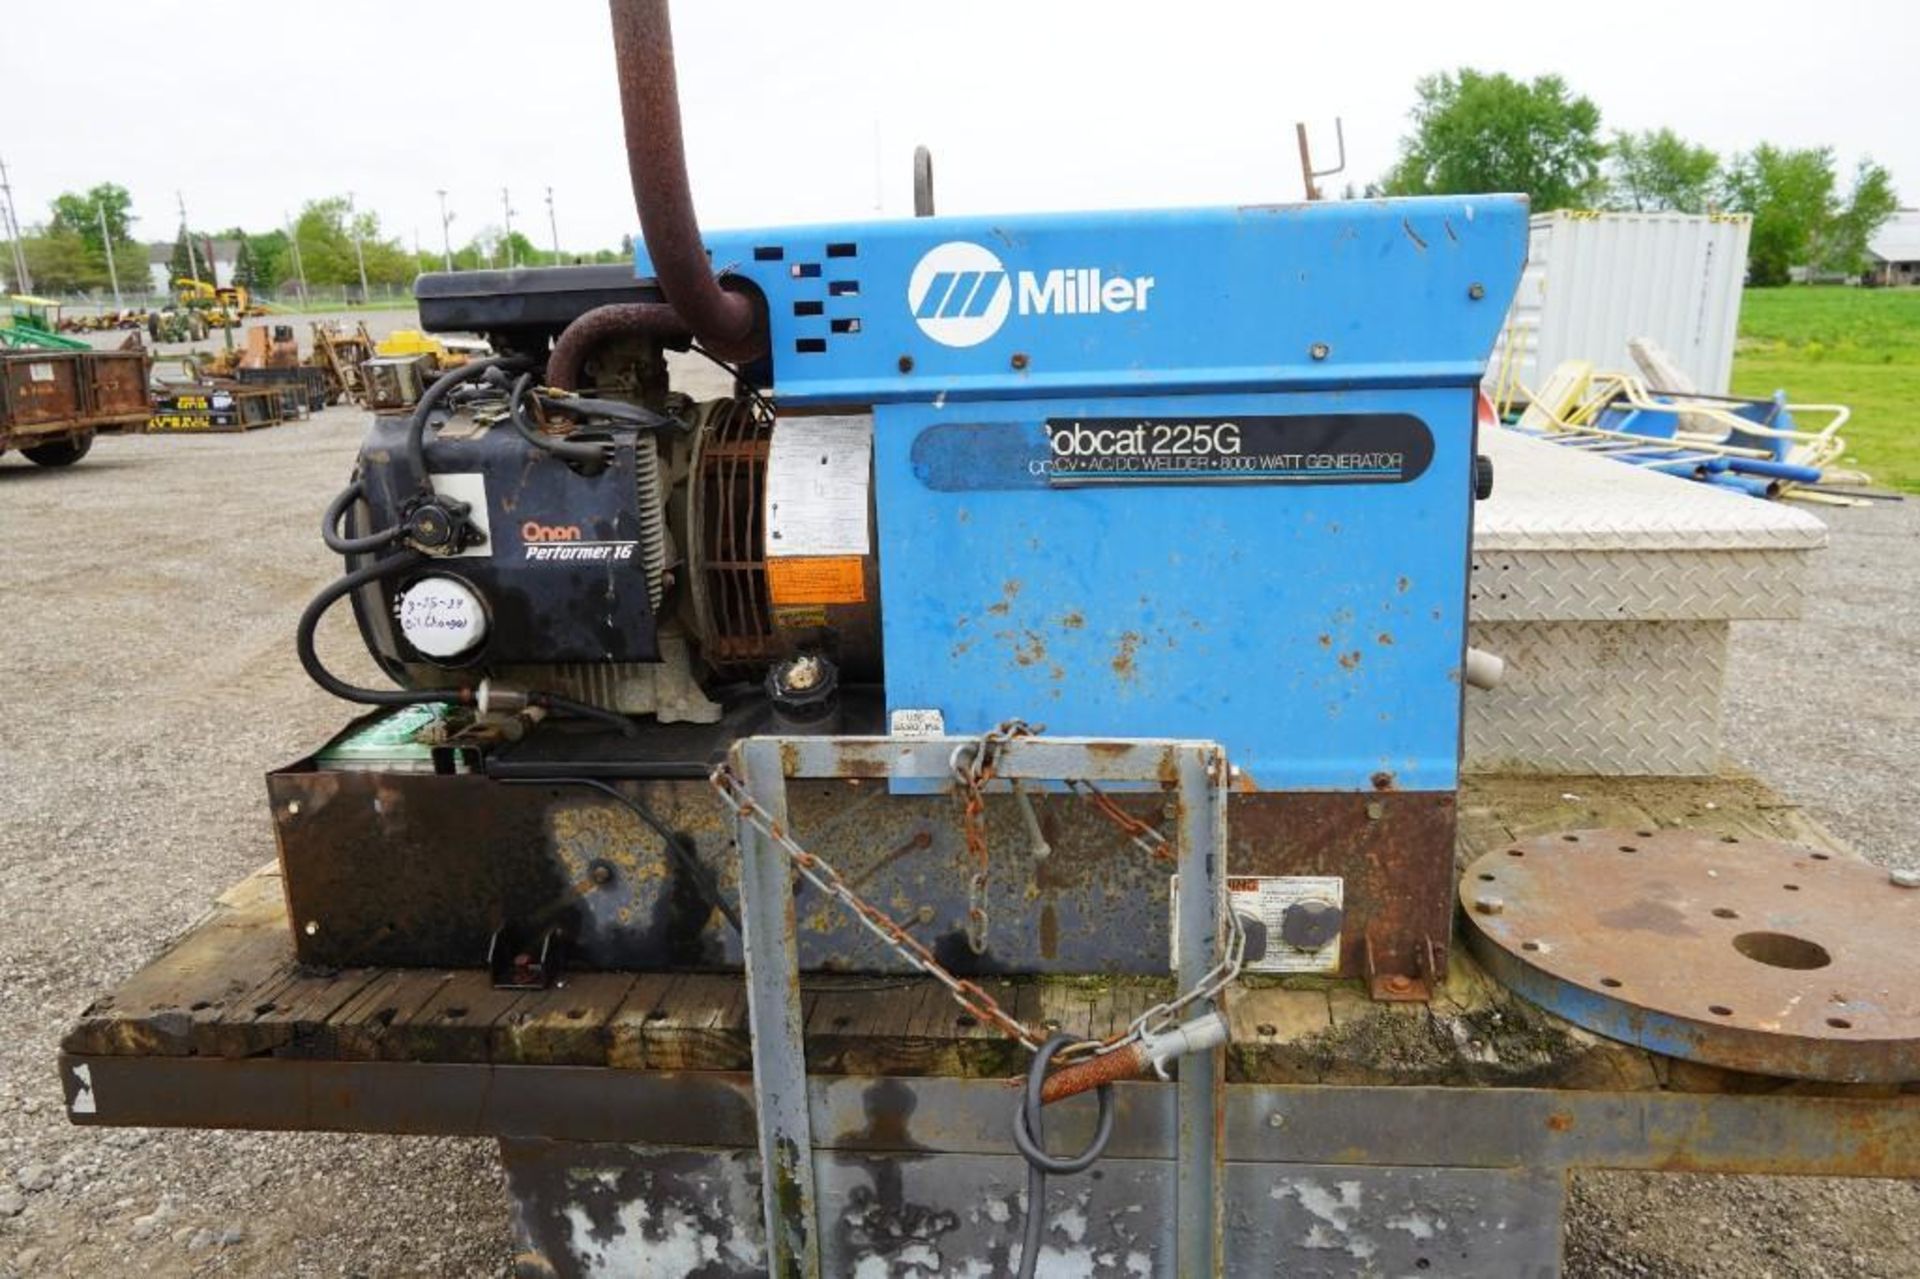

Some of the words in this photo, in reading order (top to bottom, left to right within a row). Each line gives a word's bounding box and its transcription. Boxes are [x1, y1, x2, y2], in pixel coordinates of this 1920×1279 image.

[1018, 268, 1155, 315] Miller
[1045, 422, 1145, 455] obcat
[1151, 422, 1242, 455] 225G
[1088, 456, 1140, 472] AC/DC
[1142, 456, 1208, 471] WELDER
[1220, 456, 1257, 470] 8000
[1259, 454, 1303, 469] WATT
[1305, 452, 1403, 469] GENERATOR
[522, 521, 581, 542] Onan
[525, 545, 612, 560] Performer
[614, 544, 634, 559] 16
